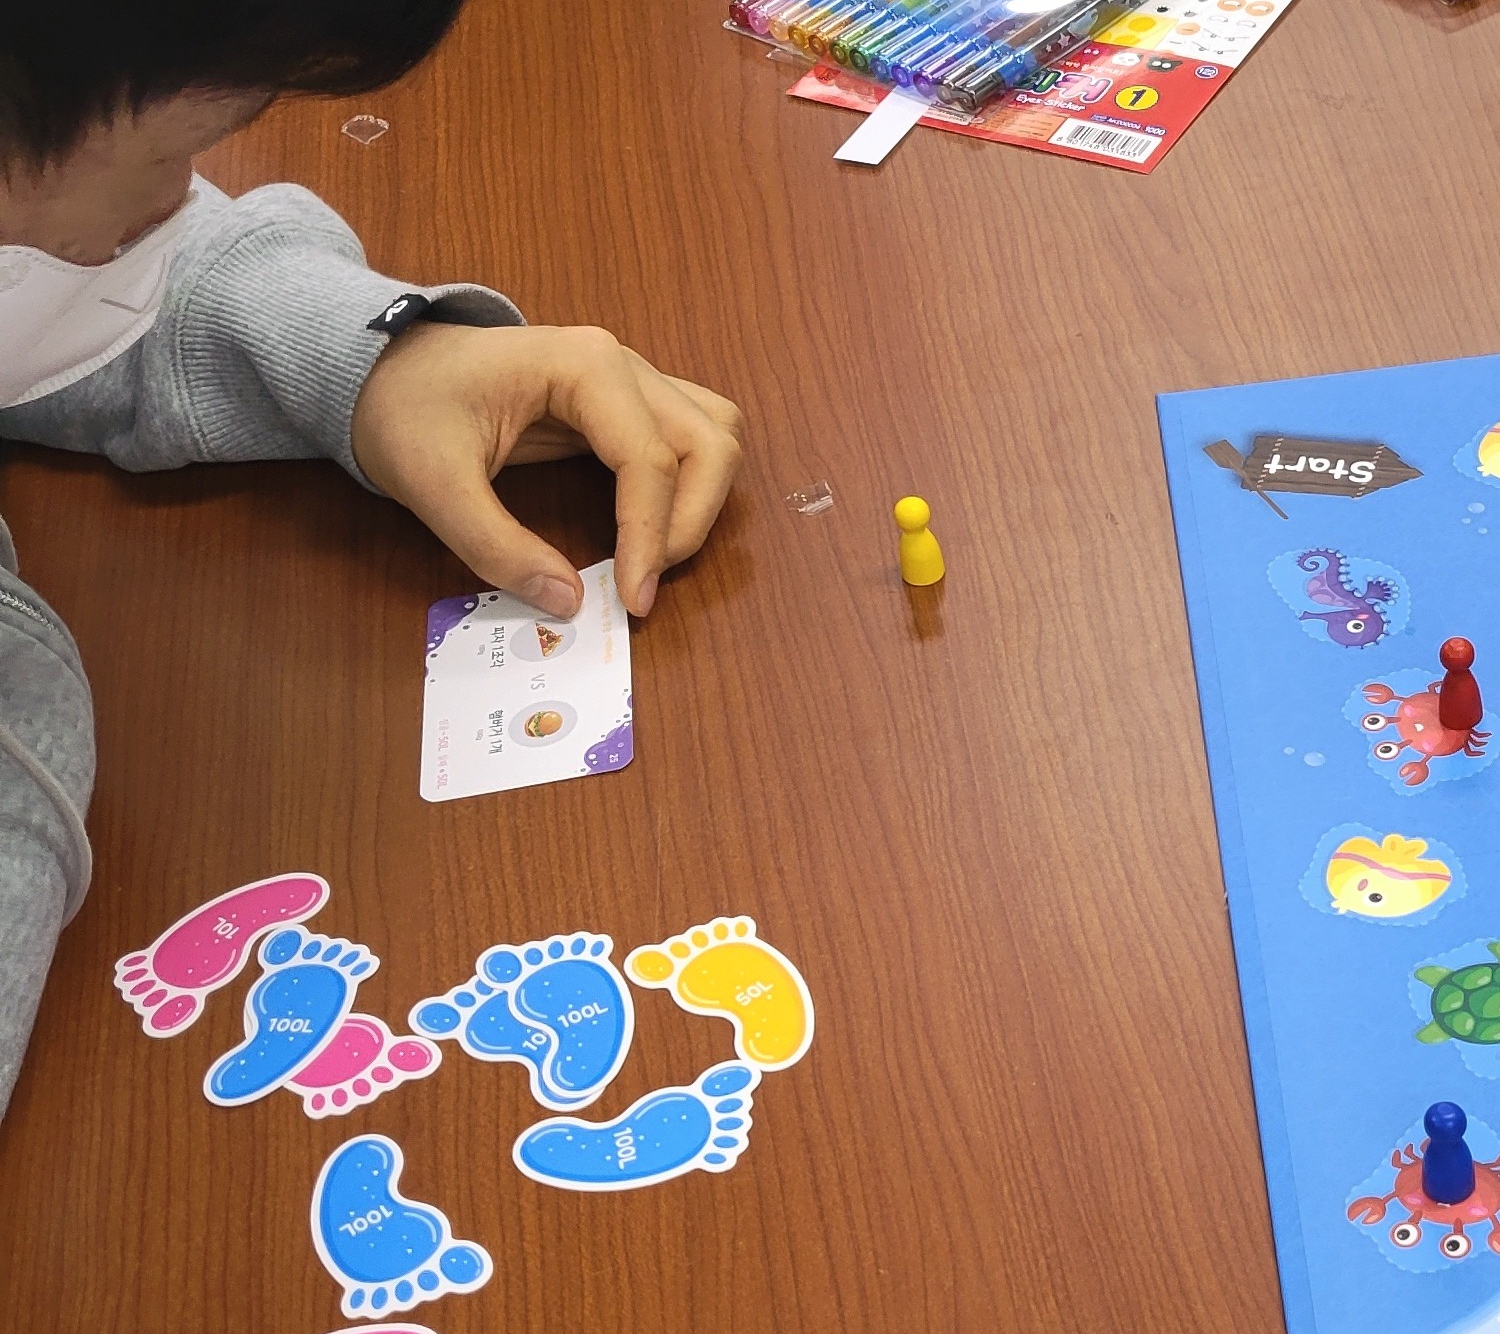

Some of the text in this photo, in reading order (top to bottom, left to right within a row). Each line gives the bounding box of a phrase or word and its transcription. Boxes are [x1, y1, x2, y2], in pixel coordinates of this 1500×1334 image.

[1264, 453, 1376, 483] Start
[490, 625, 505, 668] 피자 1조각
[530, 673, 546, 691] VS
[488, 709, 505, 755] 햄버거 1개
[211, 915, 238, 942] 10L
[734, 981, 775, 1008] 50L
[267, 1018, 314, 1035] 100L
[556, 1001, 610, 1028] 100L
[612, 1125, 638, 1170] 100L
[338, 1206, 394, 1237] 100L
